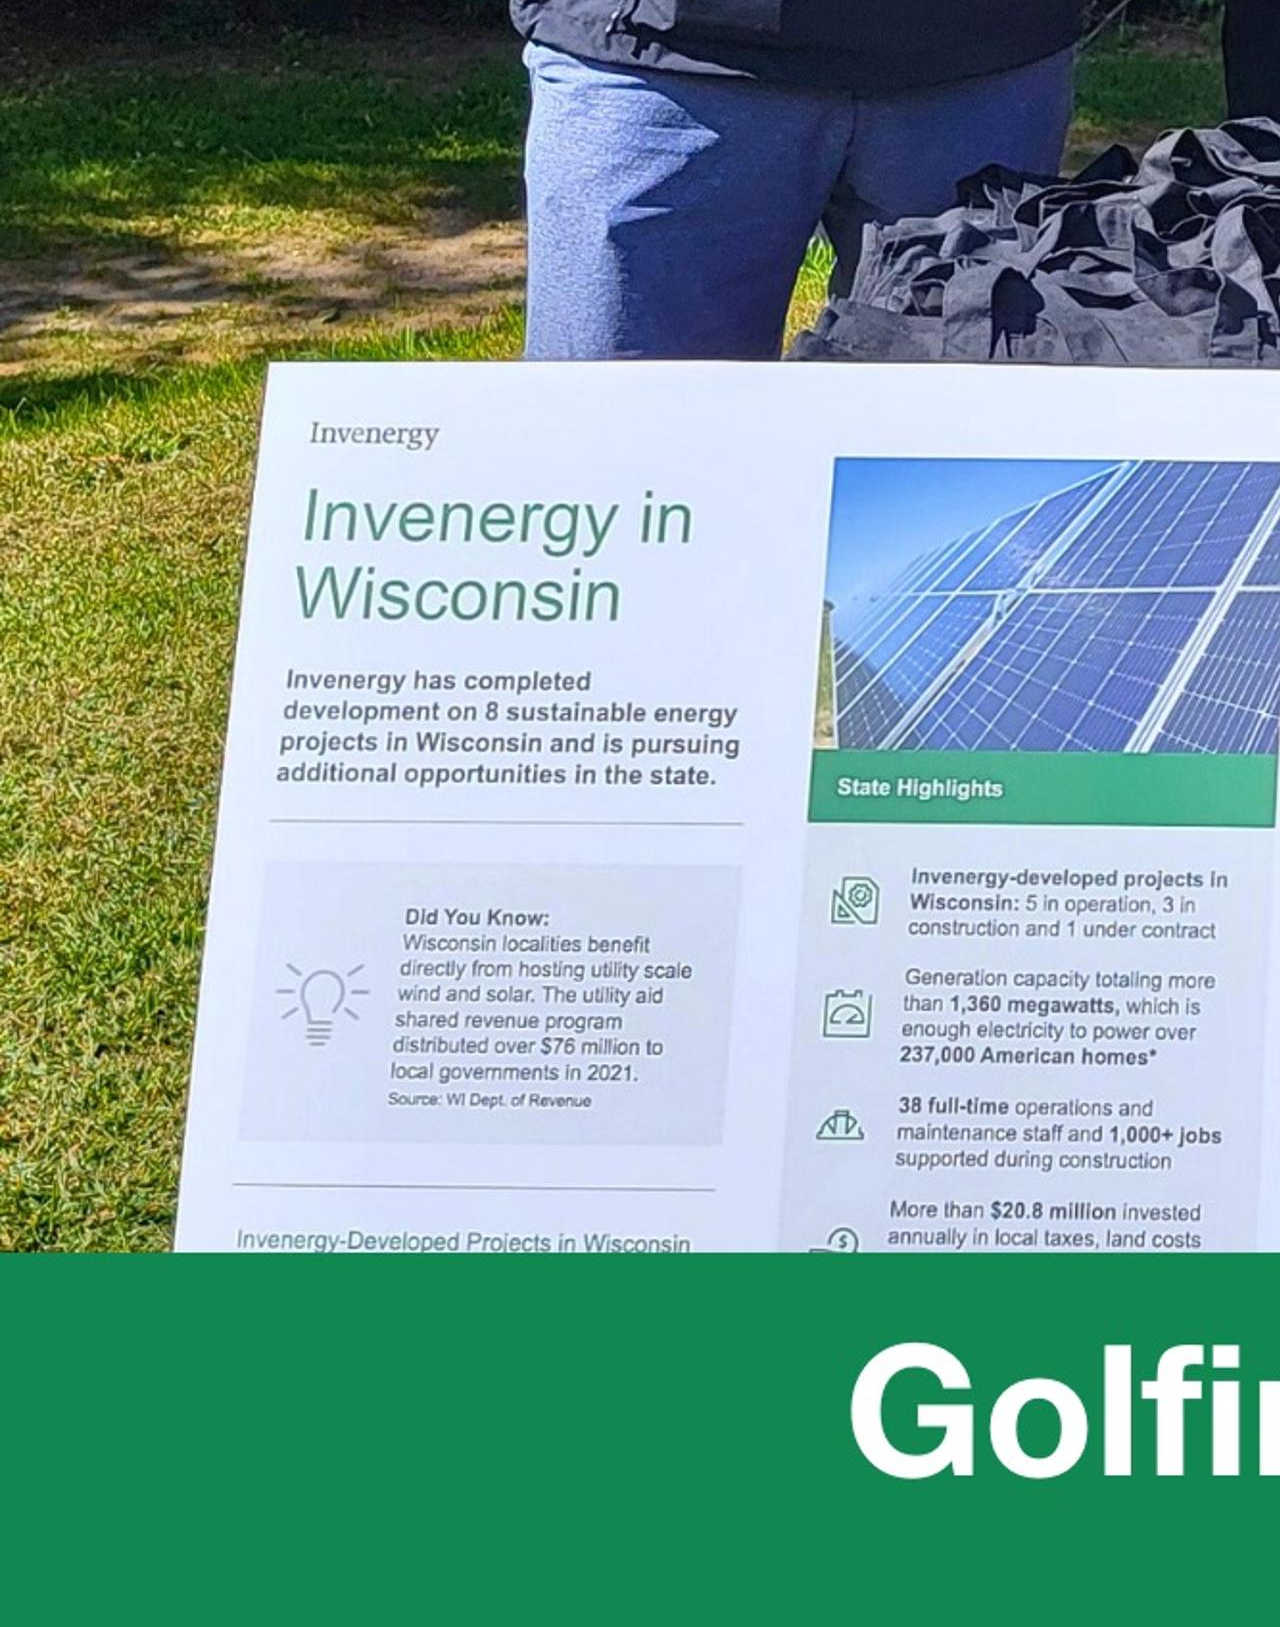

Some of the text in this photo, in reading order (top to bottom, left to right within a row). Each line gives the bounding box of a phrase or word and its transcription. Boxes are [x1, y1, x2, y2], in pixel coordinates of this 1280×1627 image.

[309, 421, 441, 452] Invenergy
[304, 488, 692, 559] Invenergy in
[295, 565, 620, 622] Wisconsin
[286, 668, 592, 696] Invenergy has completed
[283, 699, 738, 729] development on 8 sustainable energy
[279, 730, 740, 760] projects in Wisconsin and is pursuing
[276, 761, 716, 789] additional opportunities in the state.
[837, 776, 1004, 803] State Highlights
[911, 867, 1228, 892] Invenergy-developed projects in
[909, 892, 1196, 917] Wisconsin: 5 in operation, 3 in
[405, 908, 550, 927] Did You Know:
[907, 918, 1217, 940] construction and 1 under contract
[402, 933, 651, 955] Wisconsin localities benefit
[399, 958, 693, 984] directly from hosting utility scale
[905, 967, 1217, 993] Generation capacity totaling more
[397, 983, 664, 1009] wind and solar. The utility aid
[903, 994, 1201, 1018] than 1,360 megawatts, which is
[394, 1010, 623, 1034] shared revenue program
[901, 1020, 1198, 1044] enough electricity to power over
[392, 1034, 664, 1056] distributed over $76 million to
[899, 1044, 976, 1067] 237,000
[979, 1045, 1075, 1065] American
[390, 1061, 639, 1085] local governments in 2021.
[387, 1091, 593, 1110] Source: WI Dept. of Revenue
[898, 1096, 1154, 1120] 38 full-time operations and
[896, 1121, 1222, 1149] maintenance staff and 1,000+ jobs
[895, 1150, 1172, 1173] supported during construction
[889, 1199, 1201, 1222] More than $20.8 million invested
[236, 1229, 691, 1253] Invenergy-Developed Projects in Wisconsin
[887, 1228, 1202, 1250] annually in local taxes, land costs
